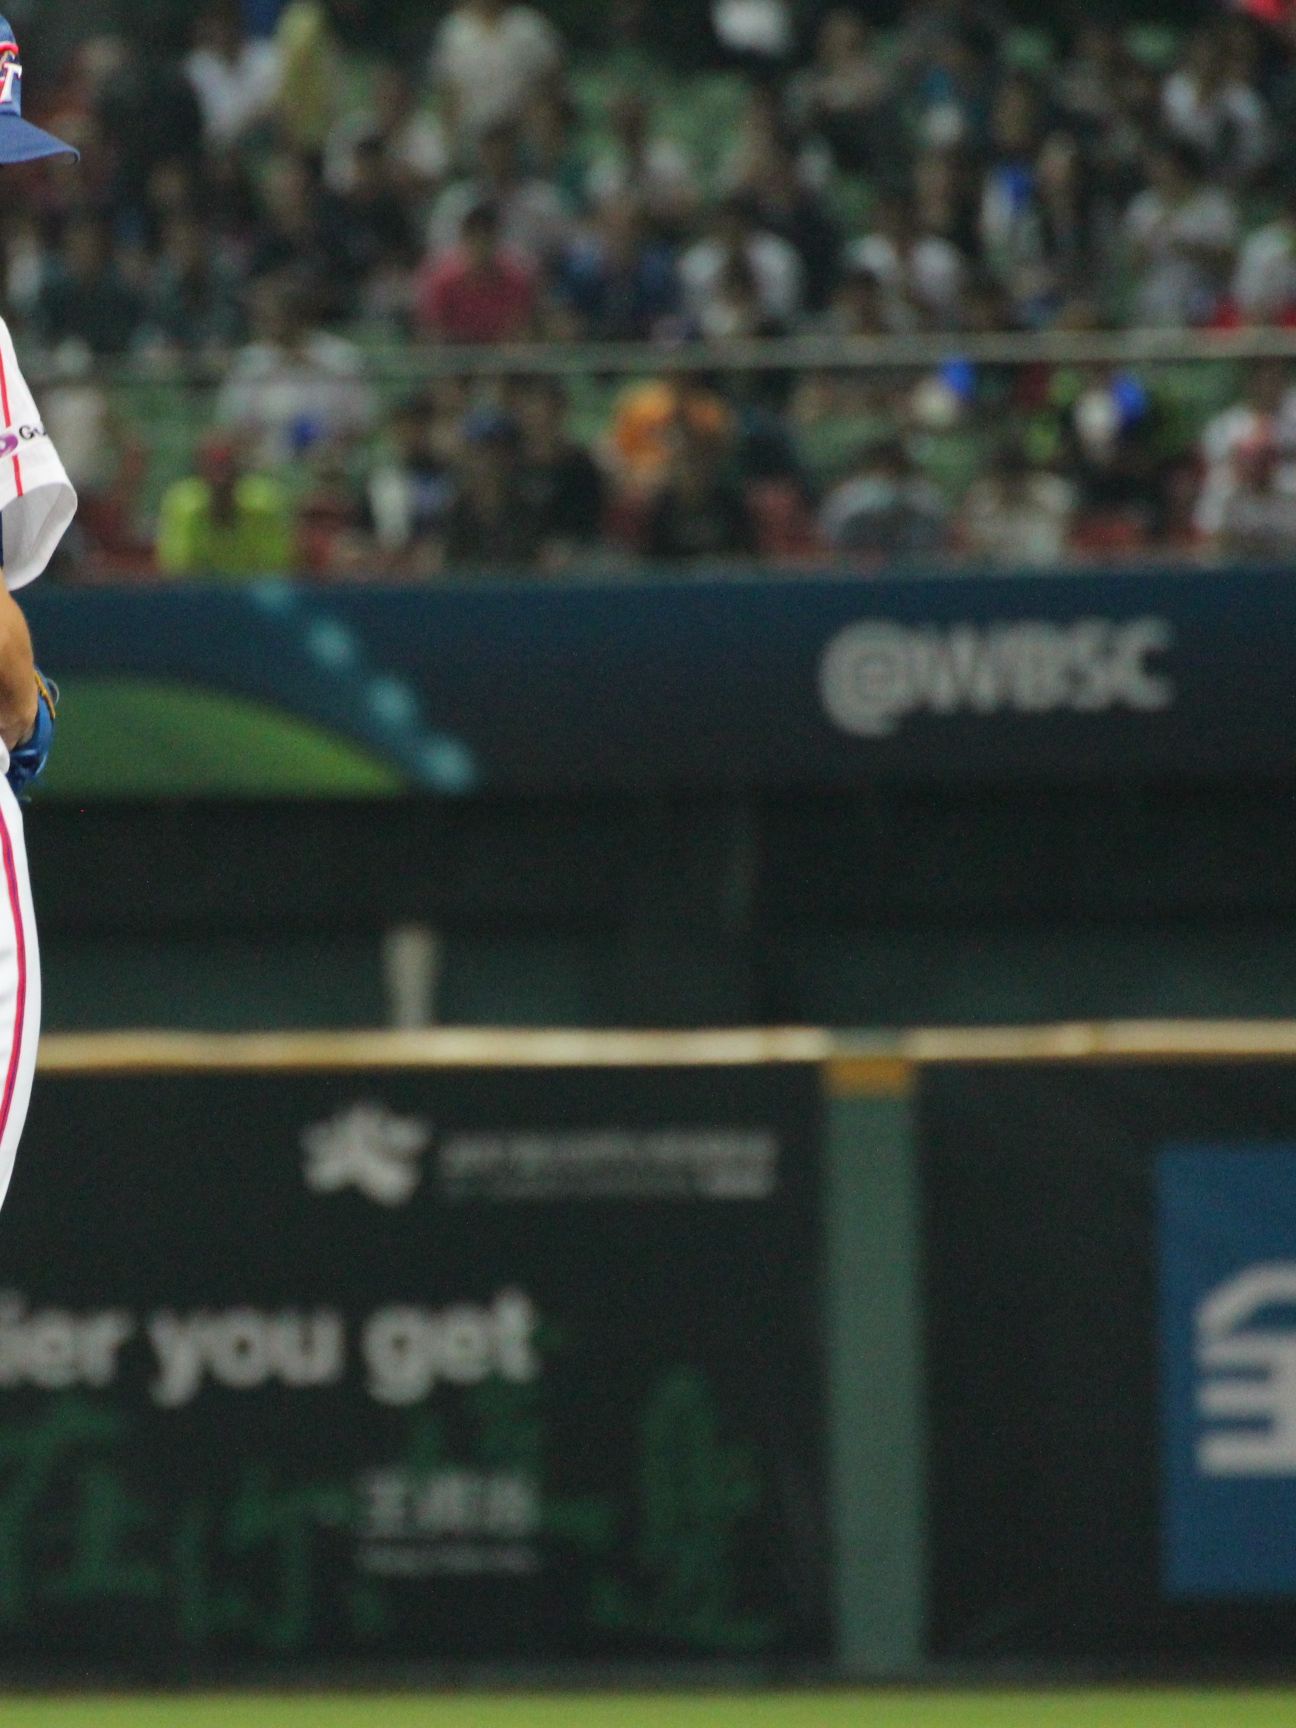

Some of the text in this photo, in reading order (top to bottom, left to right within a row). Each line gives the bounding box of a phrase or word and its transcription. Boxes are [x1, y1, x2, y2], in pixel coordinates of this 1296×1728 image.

[821, 620, 1169, 735] @WBSC
[149, 1309, 343, 1405] you
[363, 1291, 535, 1404] get
